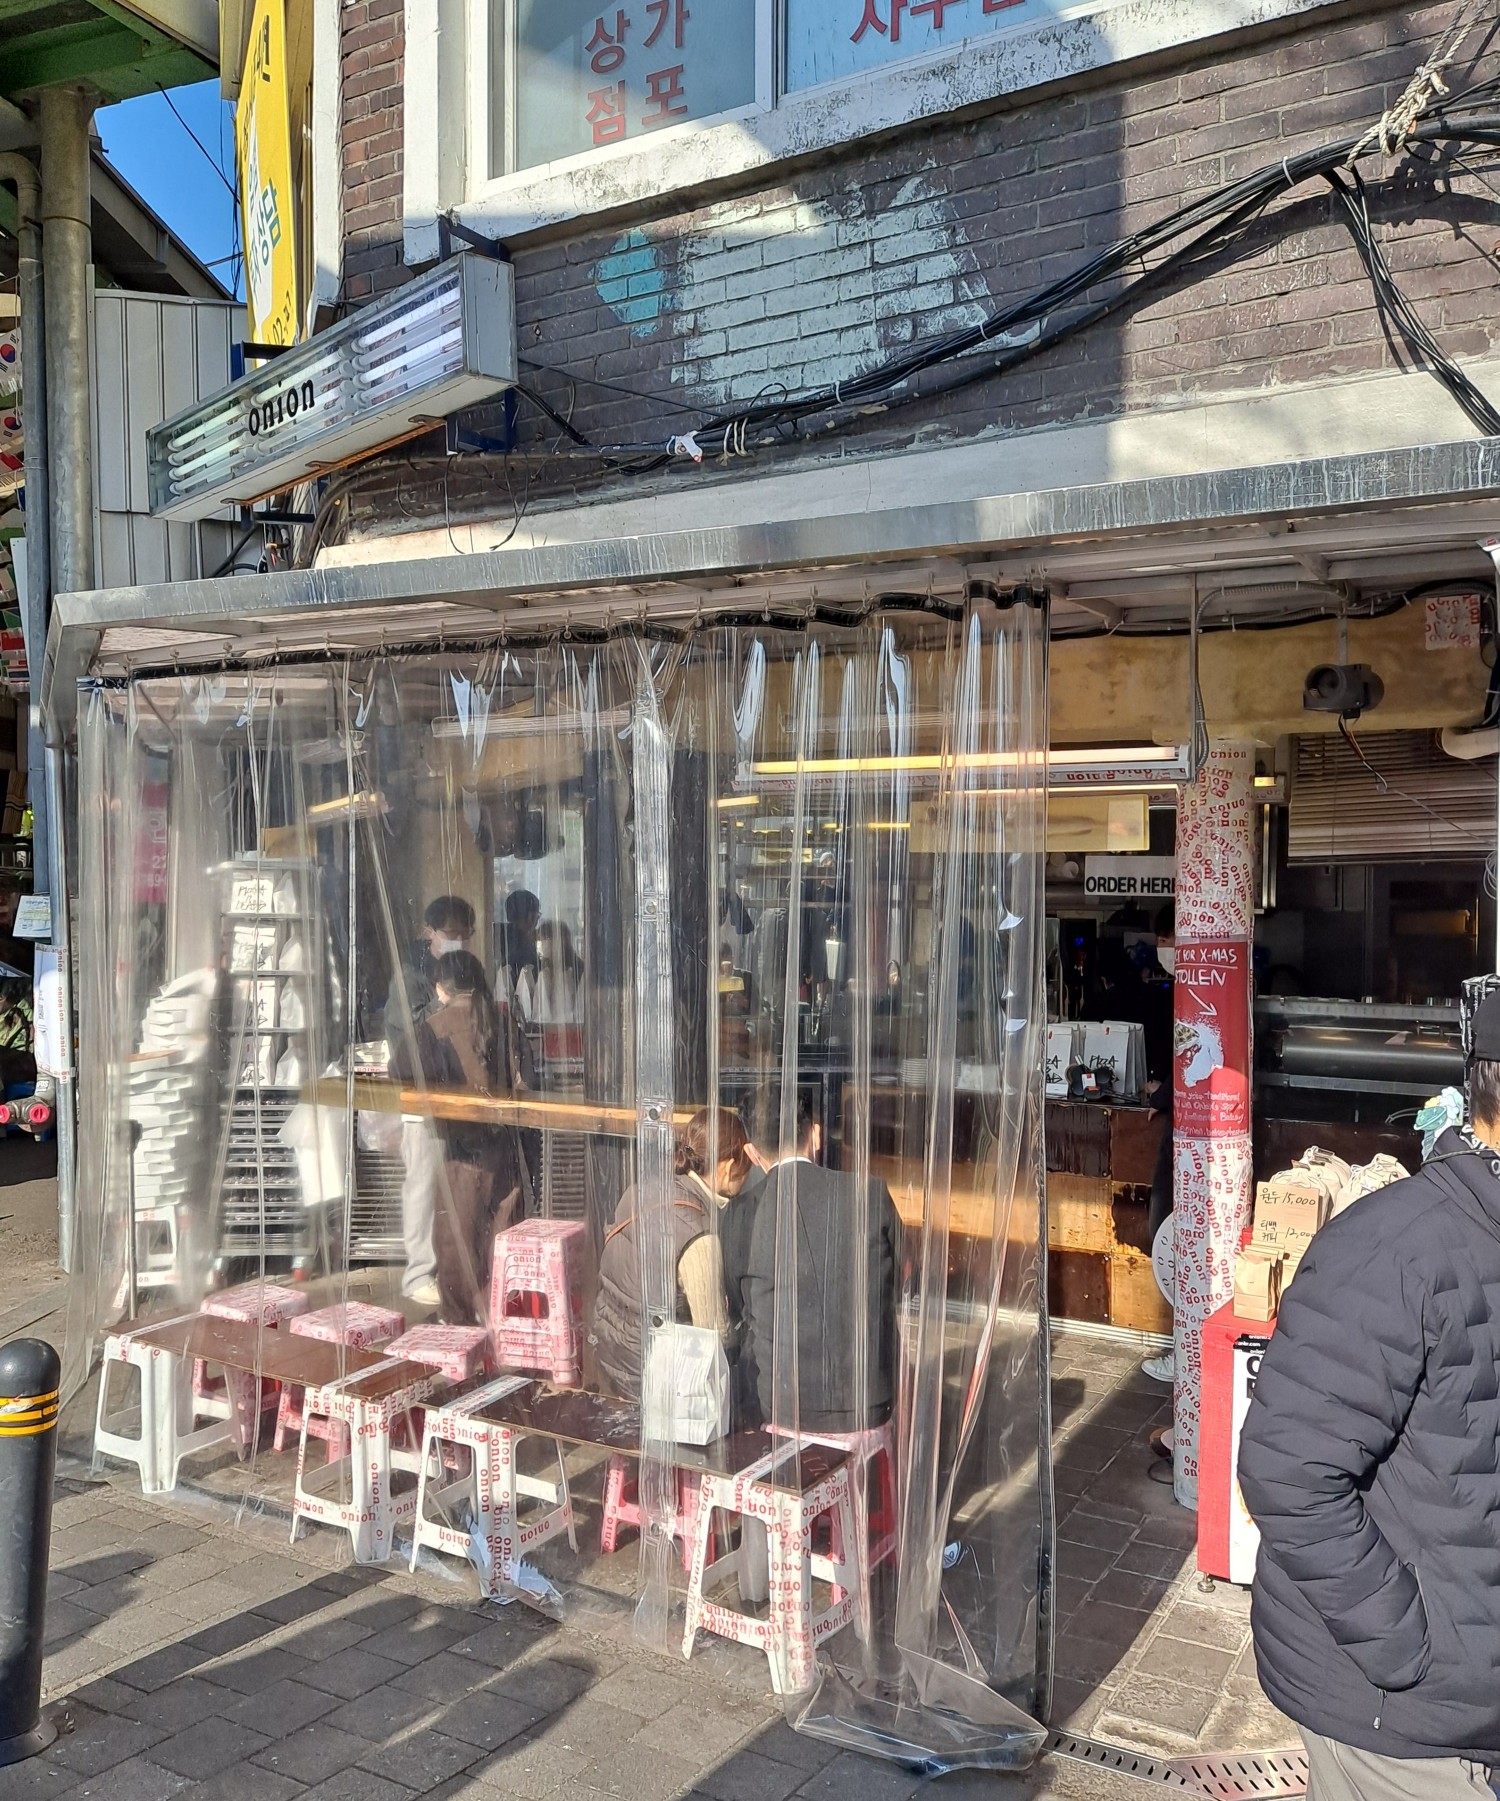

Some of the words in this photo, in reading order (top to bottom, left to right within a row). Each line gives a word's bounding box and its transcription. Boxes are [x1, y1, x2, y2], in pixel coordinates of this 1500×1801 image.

[249, 380, 315, 437] onion
[1086, 876, 1137, 893] ORDER
[1183, 949, 1196, 962] FOR
[1200, 948, 1238, 964] X-MAS
[1260, 1187, 1280, 1204] 원두
[1282, 1192, 1316, 1206] 15,000
[1262, 1232, 1277, 1243] 커피
[513, 1255, 541, 1263] onion
[1221, 1259, 1233, 1296] onion
[490, 1438, 501, 1482] onion
[371, 1462, 380, 1505] onion
[480, 1469, 490, 1512] onion
[341, 1509, 376, 1522] onion
[802, 1501, 832, 1517] onion
[439, 1526, 471, 1547] onion
[520, 1521, 550, 1543] onion
